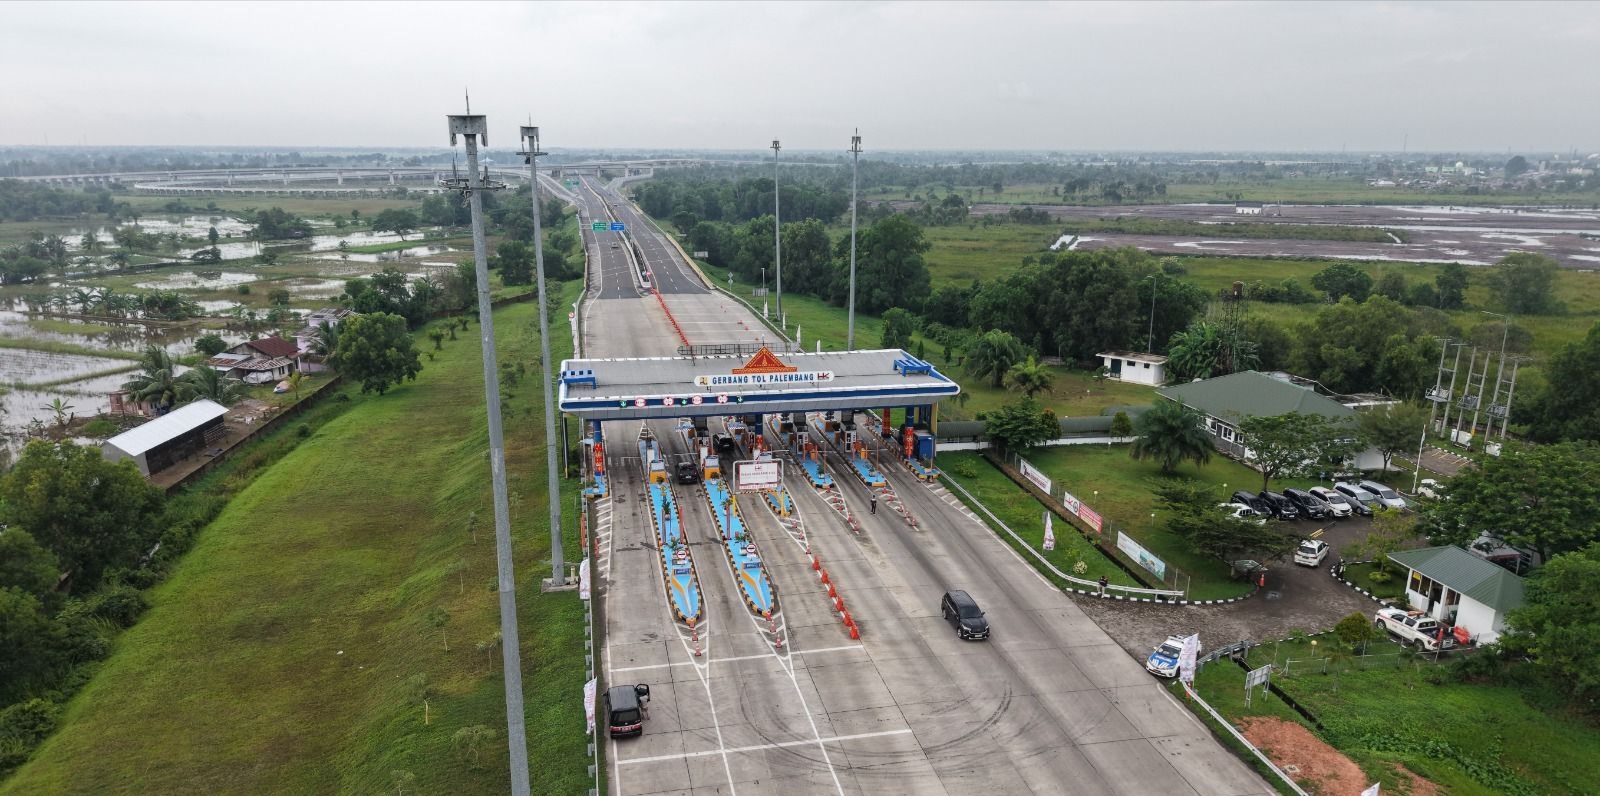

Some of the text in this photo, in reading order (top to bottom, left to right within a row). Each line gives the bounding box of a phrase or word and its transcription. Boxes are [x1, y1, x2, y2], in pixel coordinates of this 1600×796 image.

[712, 375, 748, 385] GERBANG
[752, 375, 766, 383] TOL
[770, 373, 814, 382] PALEMBANG
